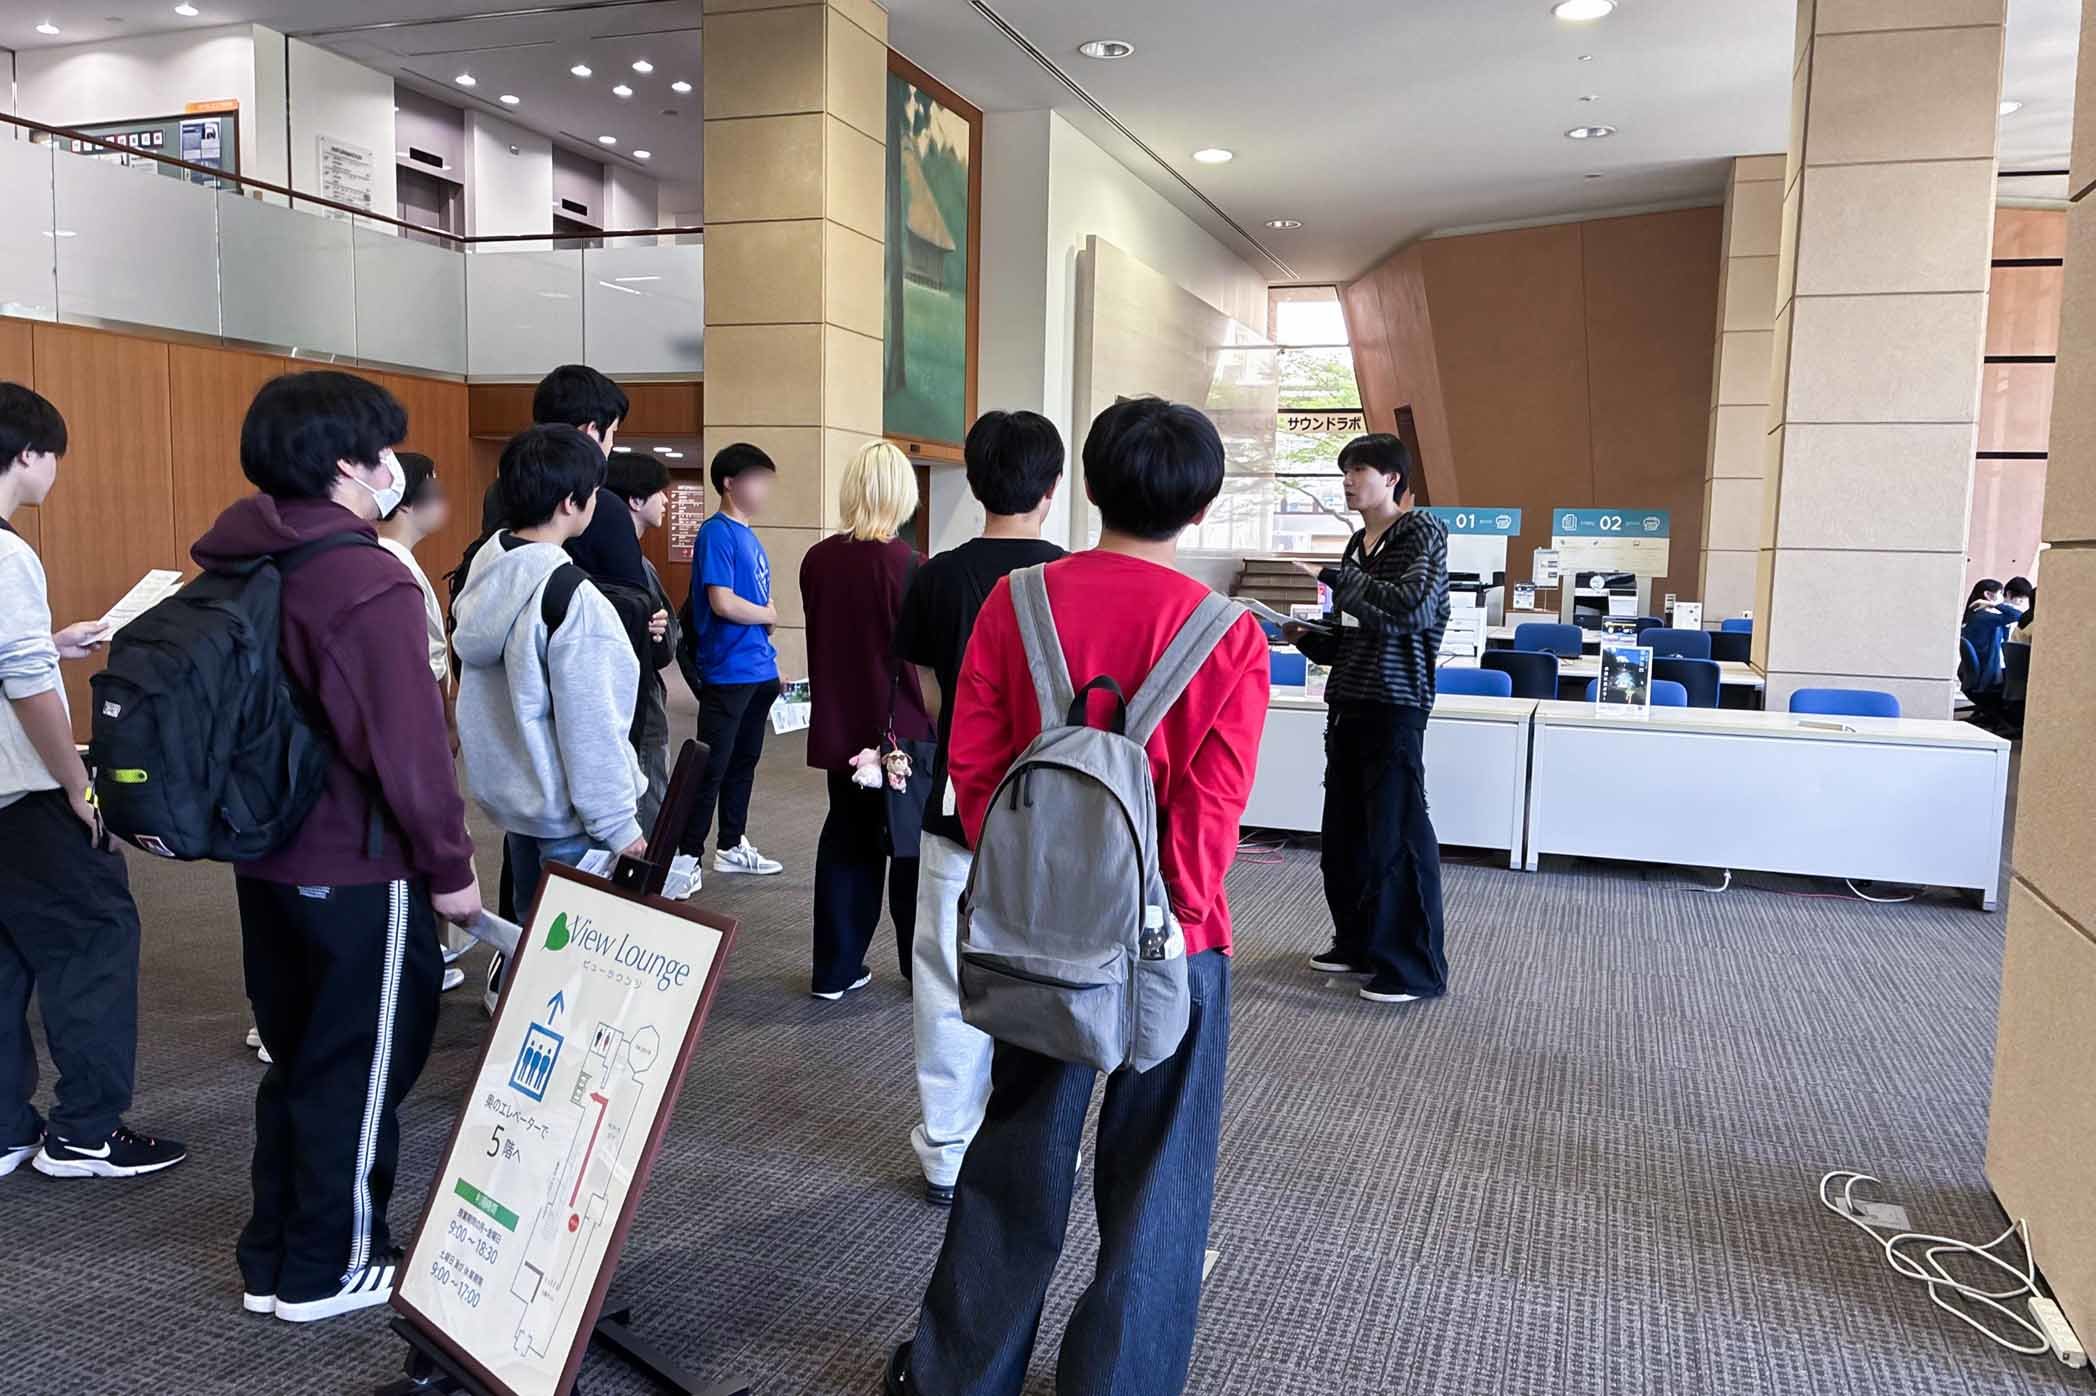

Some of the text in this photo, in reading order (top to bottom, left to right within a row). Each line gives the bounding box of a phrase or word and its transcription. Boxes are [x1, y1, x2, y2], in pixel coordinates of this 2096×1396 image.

[1287, 416, 1361, 431] サウンドラボ
[1455, 513, 1475, 529] 01
[1599, 515, 1622, 531] 02
[567, 914, 690, 992] View Lounge
[485, 1093, 549, 1140] 奥のエレベーターで
